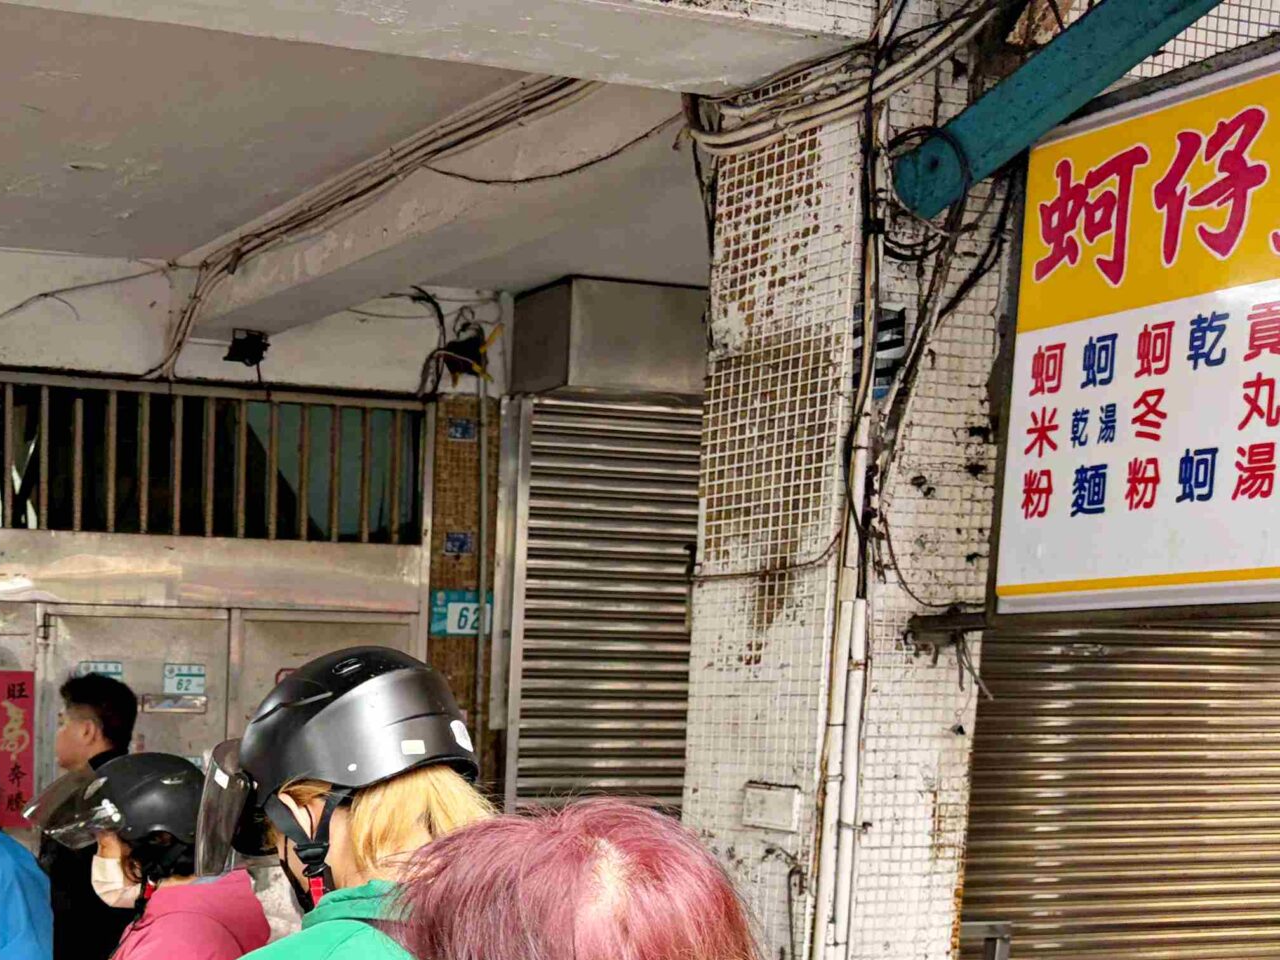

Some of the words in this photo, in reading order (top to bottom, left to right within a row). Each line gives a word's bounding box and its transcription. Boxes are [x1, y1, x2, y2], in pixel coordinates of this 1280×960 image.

[1034, 106, 1280, 283] 蚵仔
[1021, 343, 1066, 520] 蚵米粉
[1125, 321, 1175, 511] 蚵冬粉
[1175, 312, 1230, 503] 乾蚵
[176, 679, 192, 691] 62
